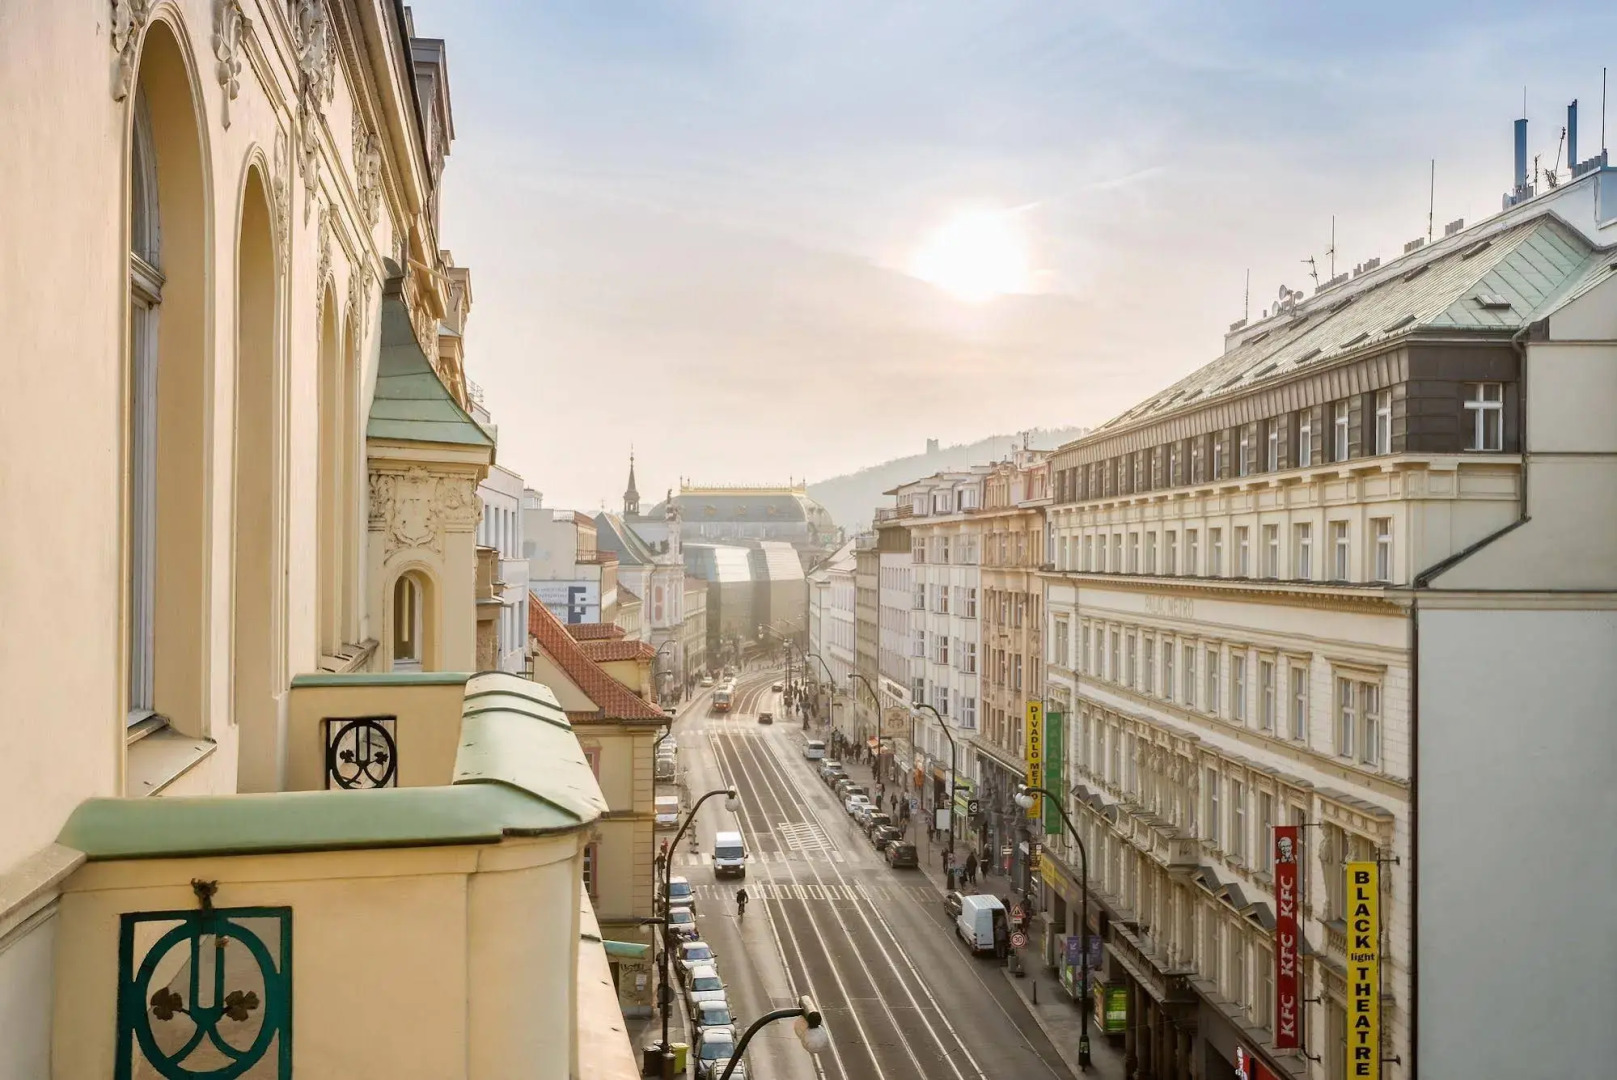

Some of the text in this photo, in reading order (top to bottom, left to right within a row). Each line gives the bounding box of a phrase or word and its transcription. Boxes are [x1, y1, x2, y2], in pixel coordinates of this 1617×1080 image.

[1030, 706, 1039, 801] DIVADLO METO
[1280, 875, 1293, 919] KFC
[1354, 871, 1370, 949] BLACK
[1280, 934, 1294, 978] KFC
[1350, 952, 1375, 963] light
[1280, 995, 1295, 1038] KFC
[1354, 967, 1371, 1076] THEATRE
